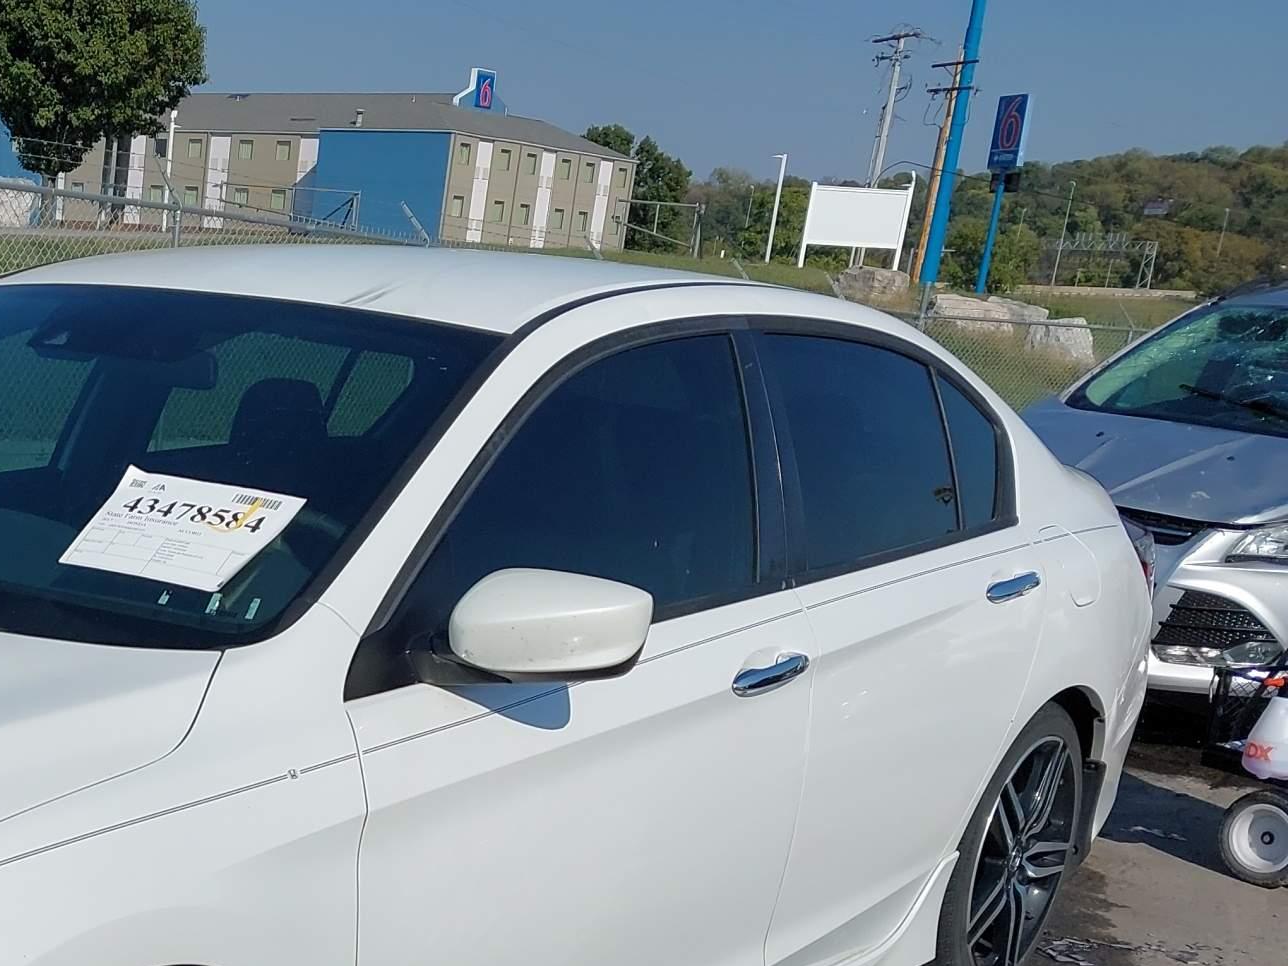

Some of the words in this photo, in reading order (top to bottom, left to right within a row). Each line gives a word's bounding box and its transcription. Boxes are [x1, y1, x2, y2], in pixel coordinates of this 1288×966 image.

[480, 78, 491, 107] 6
[999, 96, 1021, 149] 6
[123, 496, 266, 533] 43478584
